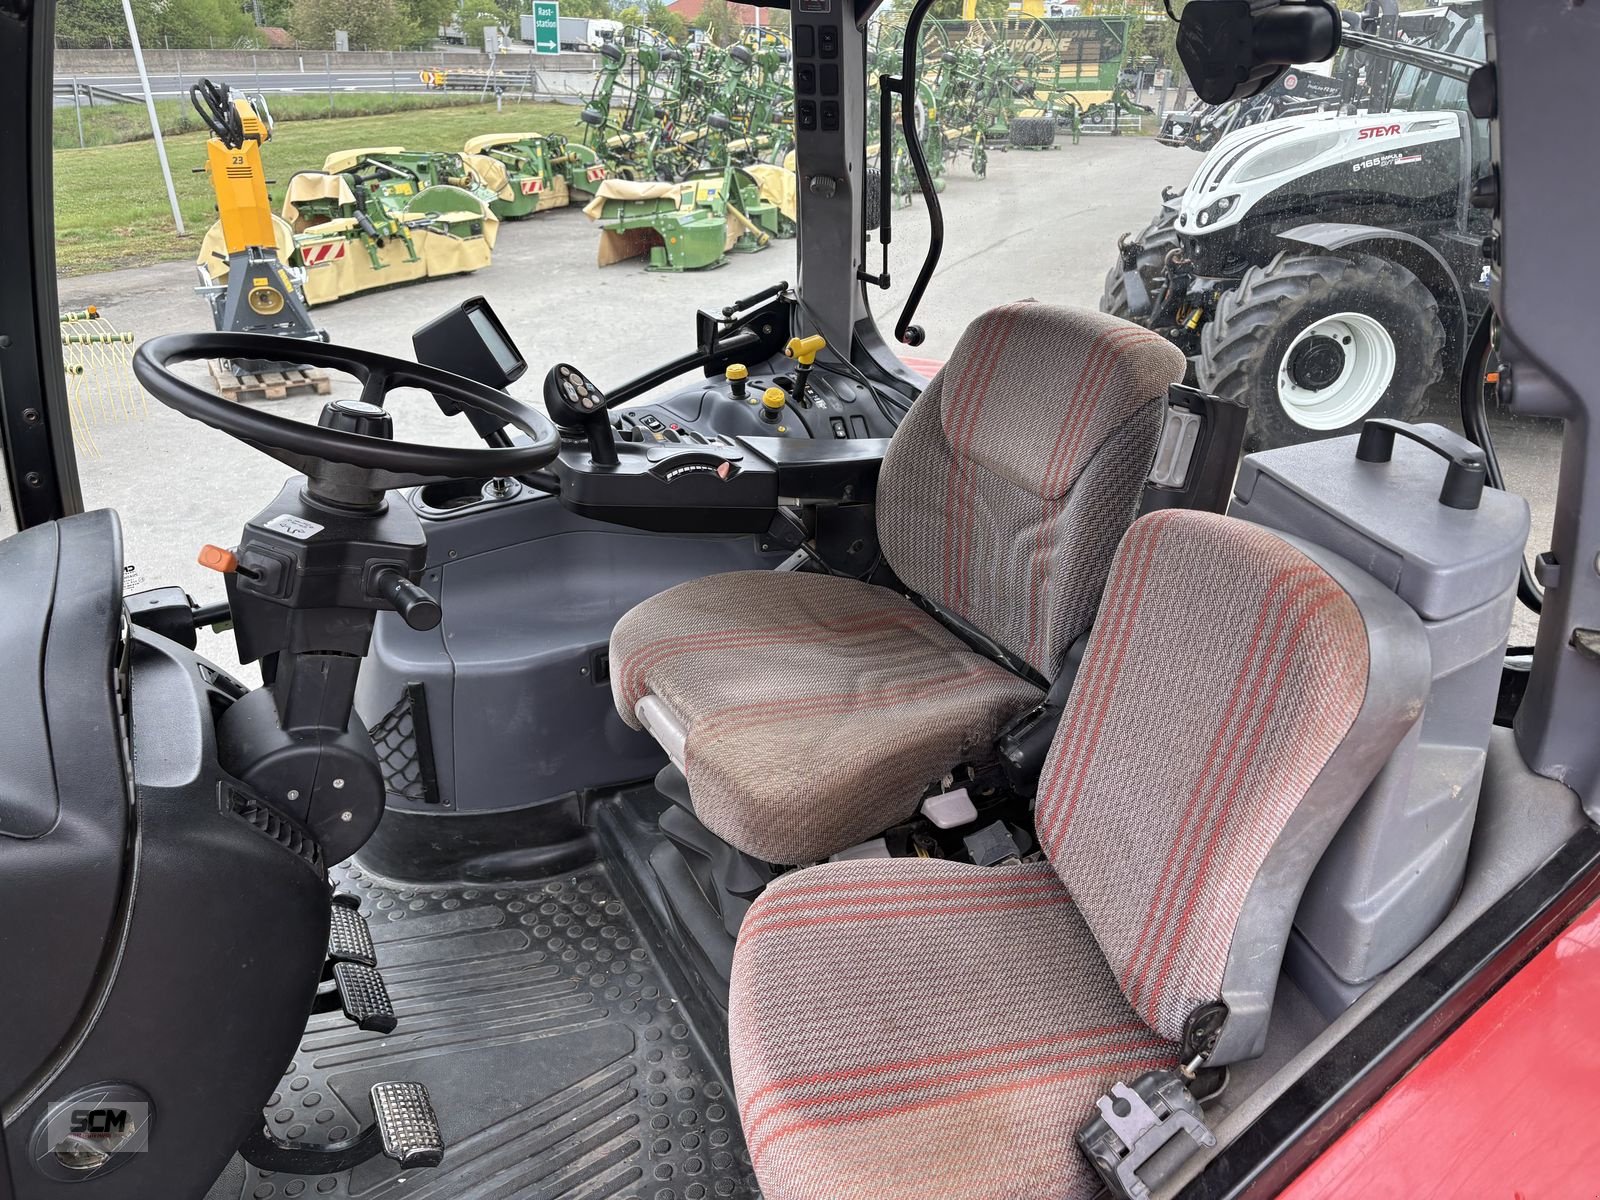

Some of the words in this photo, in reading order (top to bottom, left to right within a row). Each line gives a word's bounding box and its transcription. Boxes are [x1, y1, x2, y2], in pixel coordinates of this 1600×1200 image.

[537, 7, 554, 16] Rast-
[536, 19, 556, 28] station
[1357, 124, 1401, 140] STEYR
[232, 156, 244, 165] 23
[1352, 157, 1381, 172] 6165
